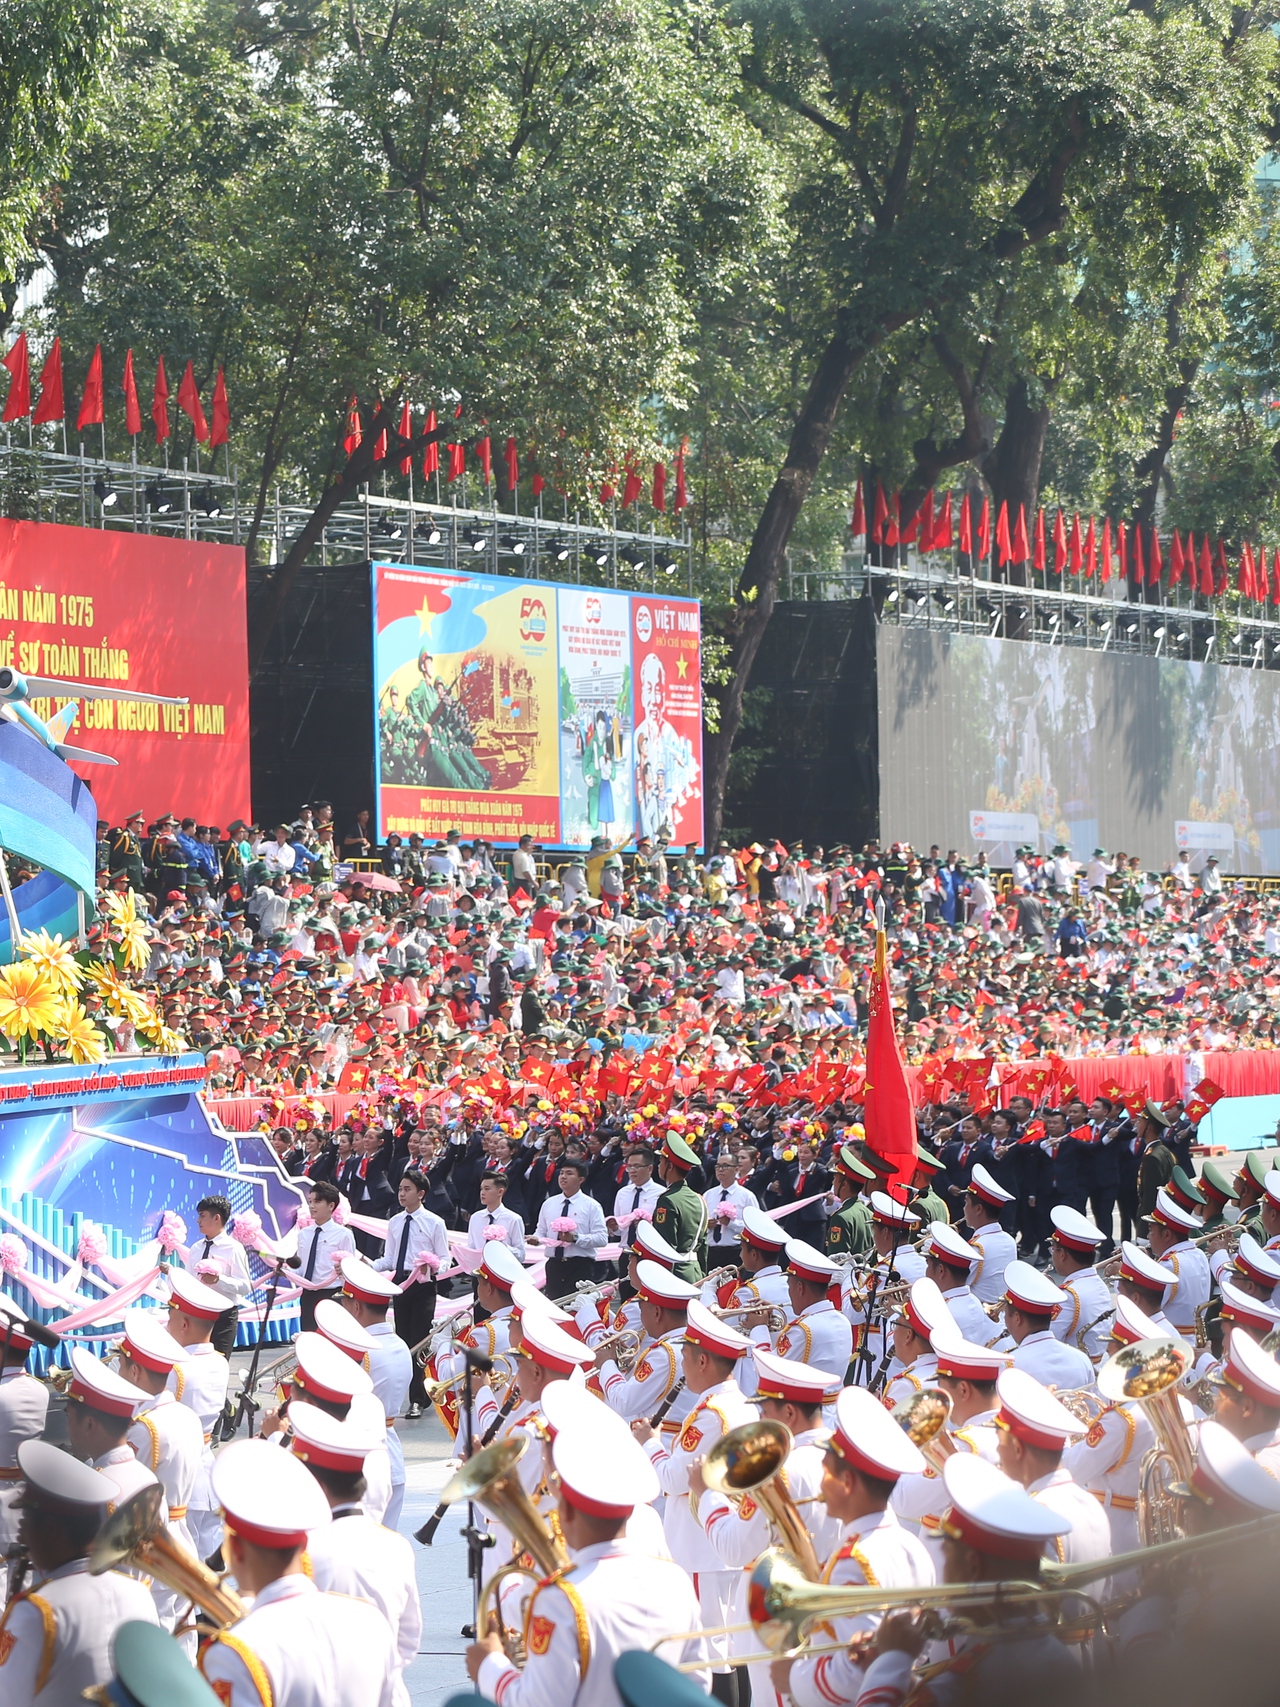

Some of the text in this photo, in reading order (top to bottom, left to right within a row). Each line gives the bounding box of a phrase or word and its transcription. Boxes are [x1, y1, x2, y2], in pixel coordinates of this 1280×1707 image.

[22, 584, 57, 625] NĂM
[60, 594, 94, 628] 1975
[654, 604, 676, 634] VIỆT
[677, 611, 699, 633] NAM
[42, 637, 80, 678] TOÀN
[83, 636, 129, 681] THẮNG
[655, 633, 698, 650] HỒ CHÍ MINH
[84, 698, 115, 731] CON
[163, 696, 191, 740] VIỆT
[194, 703, 225, 736] NAM
[53, 1078, 84, 1095] PHONG
